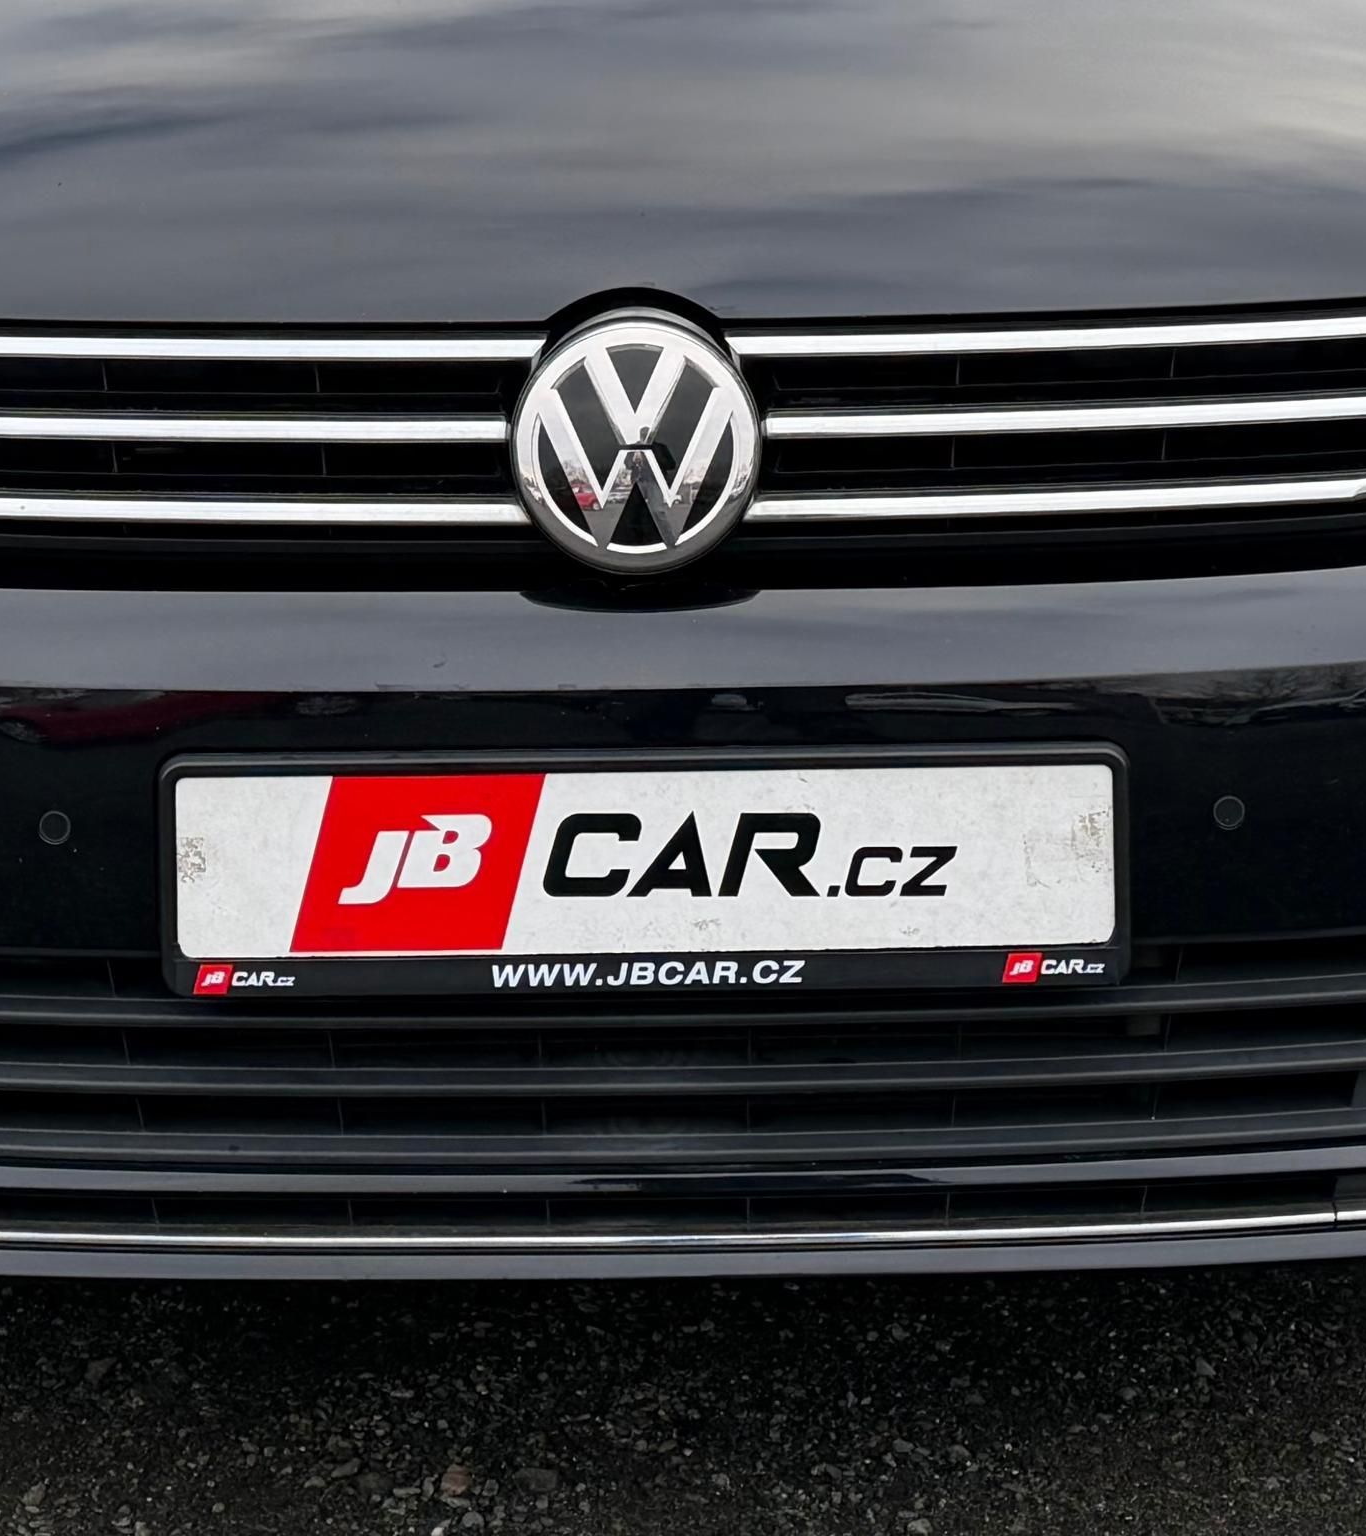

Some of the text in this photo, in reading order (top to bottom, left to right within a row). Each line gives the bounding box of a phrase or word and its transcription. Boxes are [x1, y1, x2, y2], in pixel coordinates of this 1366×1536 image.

[523, 324, 747, 562] VW
[338, 814, 493, 905] JB
[491, 960, 805, 988] WWW.JBCAR.CZ
